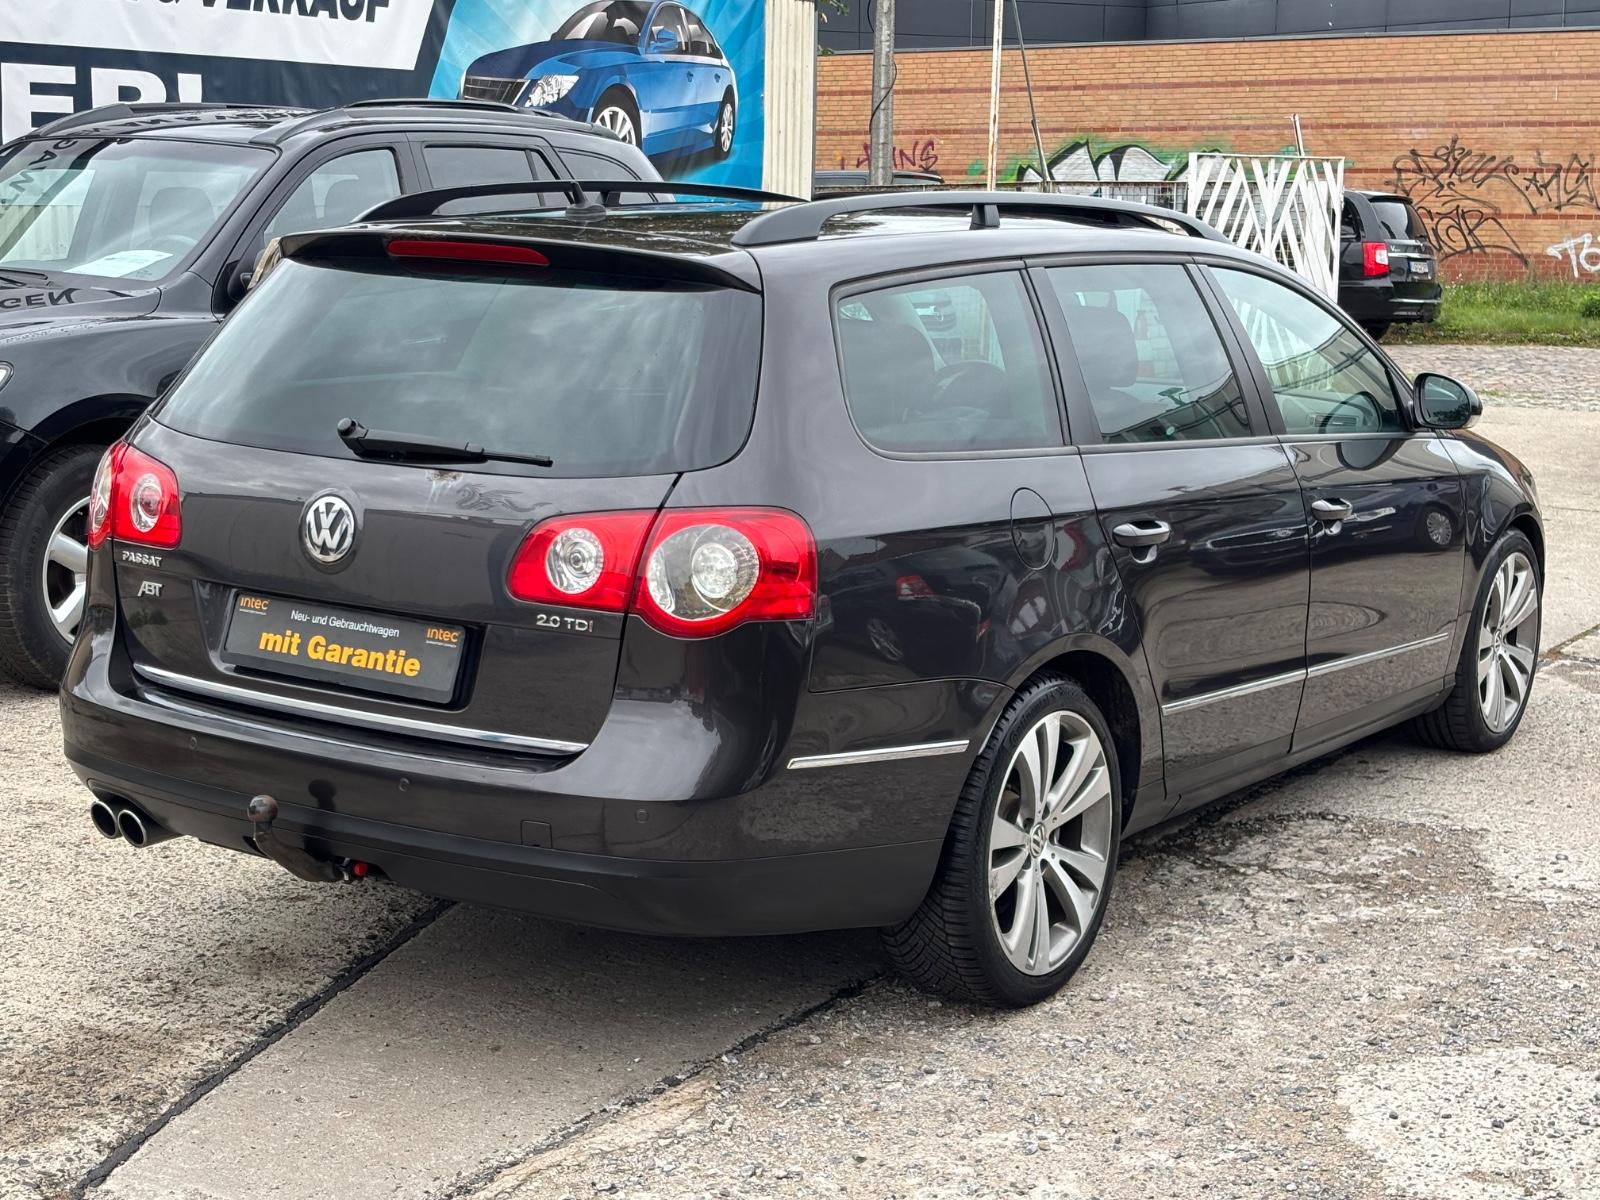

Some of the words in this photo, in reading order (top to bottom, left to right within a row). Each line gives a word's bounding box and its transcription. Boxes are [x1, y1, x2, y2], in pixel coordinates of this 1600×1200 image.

[305, 495, 355, 563] VW
[122, 550, 162, 567] PASSAT
[137, 580, 163, 597] ABT
[240, 596, 269, 611] intec
[290, 609, 311, 623] Neu-
[311, 615, 328, 626] und
[328, 616, 400, 638] Gebrauchtwagen
[425, 627, 459, 643] intec
[259, 629, 302, 656] mit
[307, 634, 421, 677] Garantie
